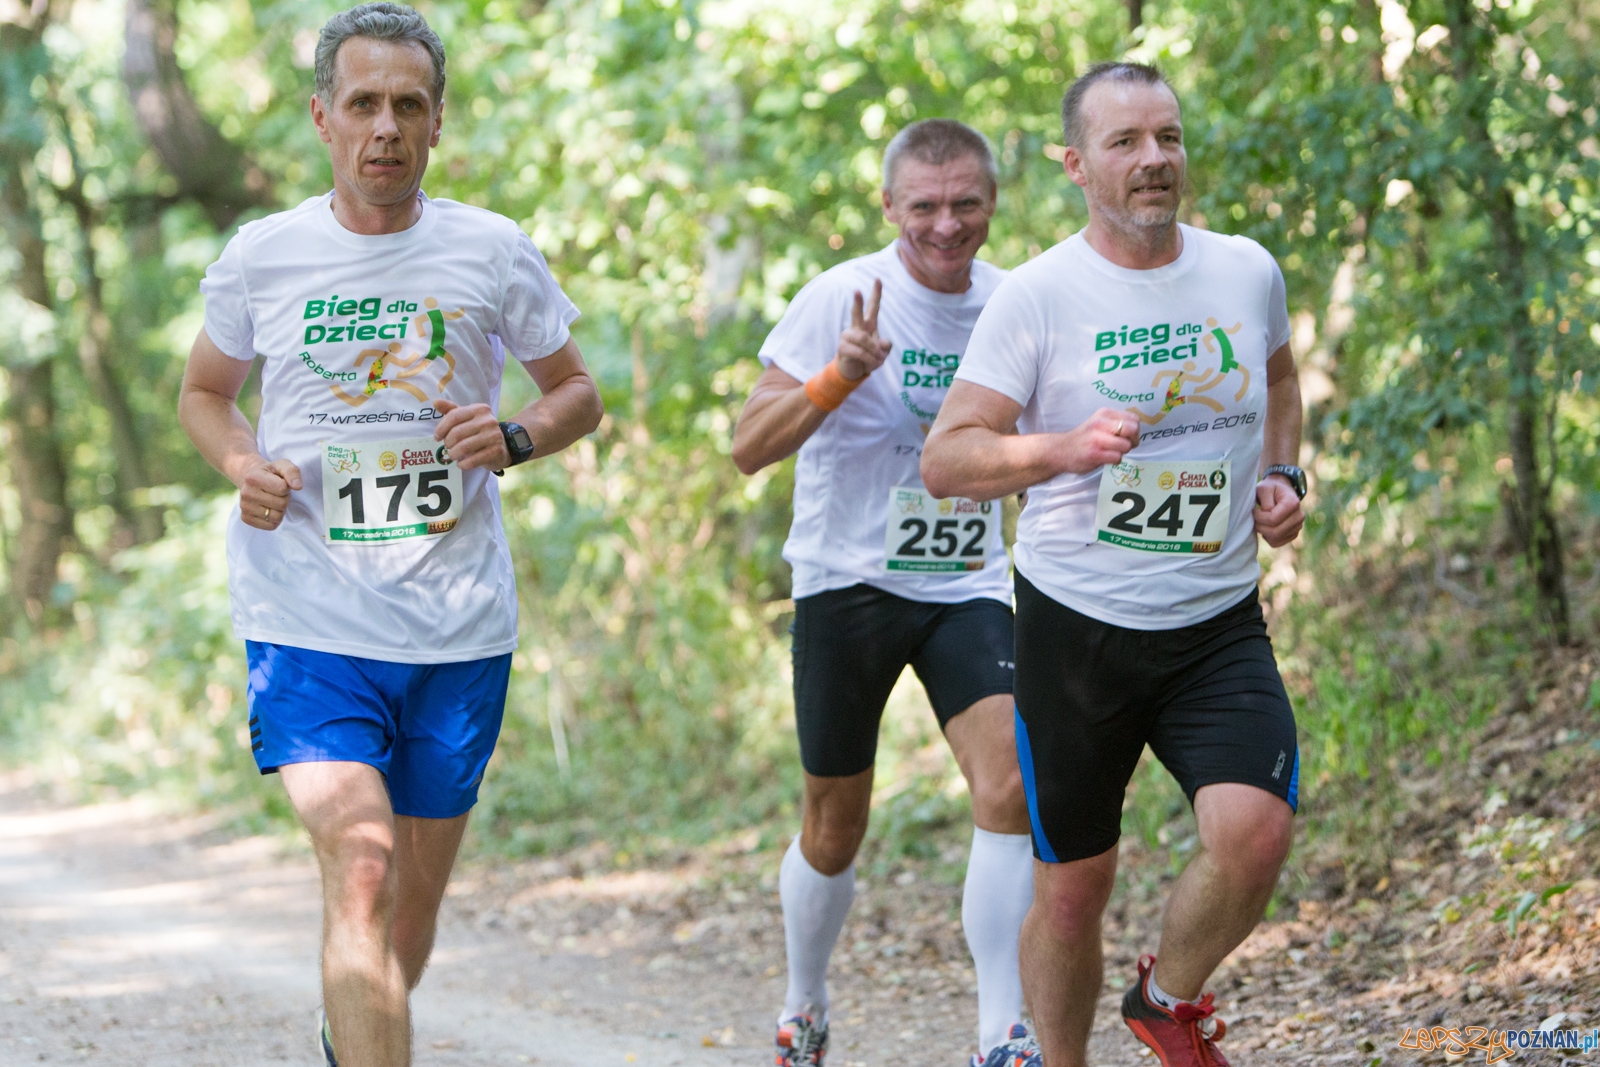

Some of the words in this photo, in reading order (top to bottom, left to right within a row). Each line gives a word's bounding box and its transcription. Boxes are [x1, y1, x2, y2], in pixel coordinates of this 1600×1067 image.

[303, 295, 382, 321] Bieg
[387, 300, 418, 313] dla
[304, 316, 409, 345] Dzieci
[1095, 323, 1170, 351] Bieg
[1176, 323, 1202, 336] dla
[299, 351, 357, 382] Roberta
[901, 349, 960, 371] Bieg
[1098, 337, 1198, 374] Dzieci
[903, 370, 954, 388] Dzie
[1092, 379, 1154, 403] Roberta
[308, 413, 328, 425] 17
[331, 409, 414, 424] września
[1211, 412, 1257, 431] 2016
[401, 457, 435, 470] POLSKA
[338, 469, 452, 524] 175
[1107, 491, 1221, 537] 247
[391, 527, 416, 537] 2016
[896, 517, 987, 557] 252
[1110, 535, 1121, 543] 17
[1156, 543, 1181, 551] 2016
